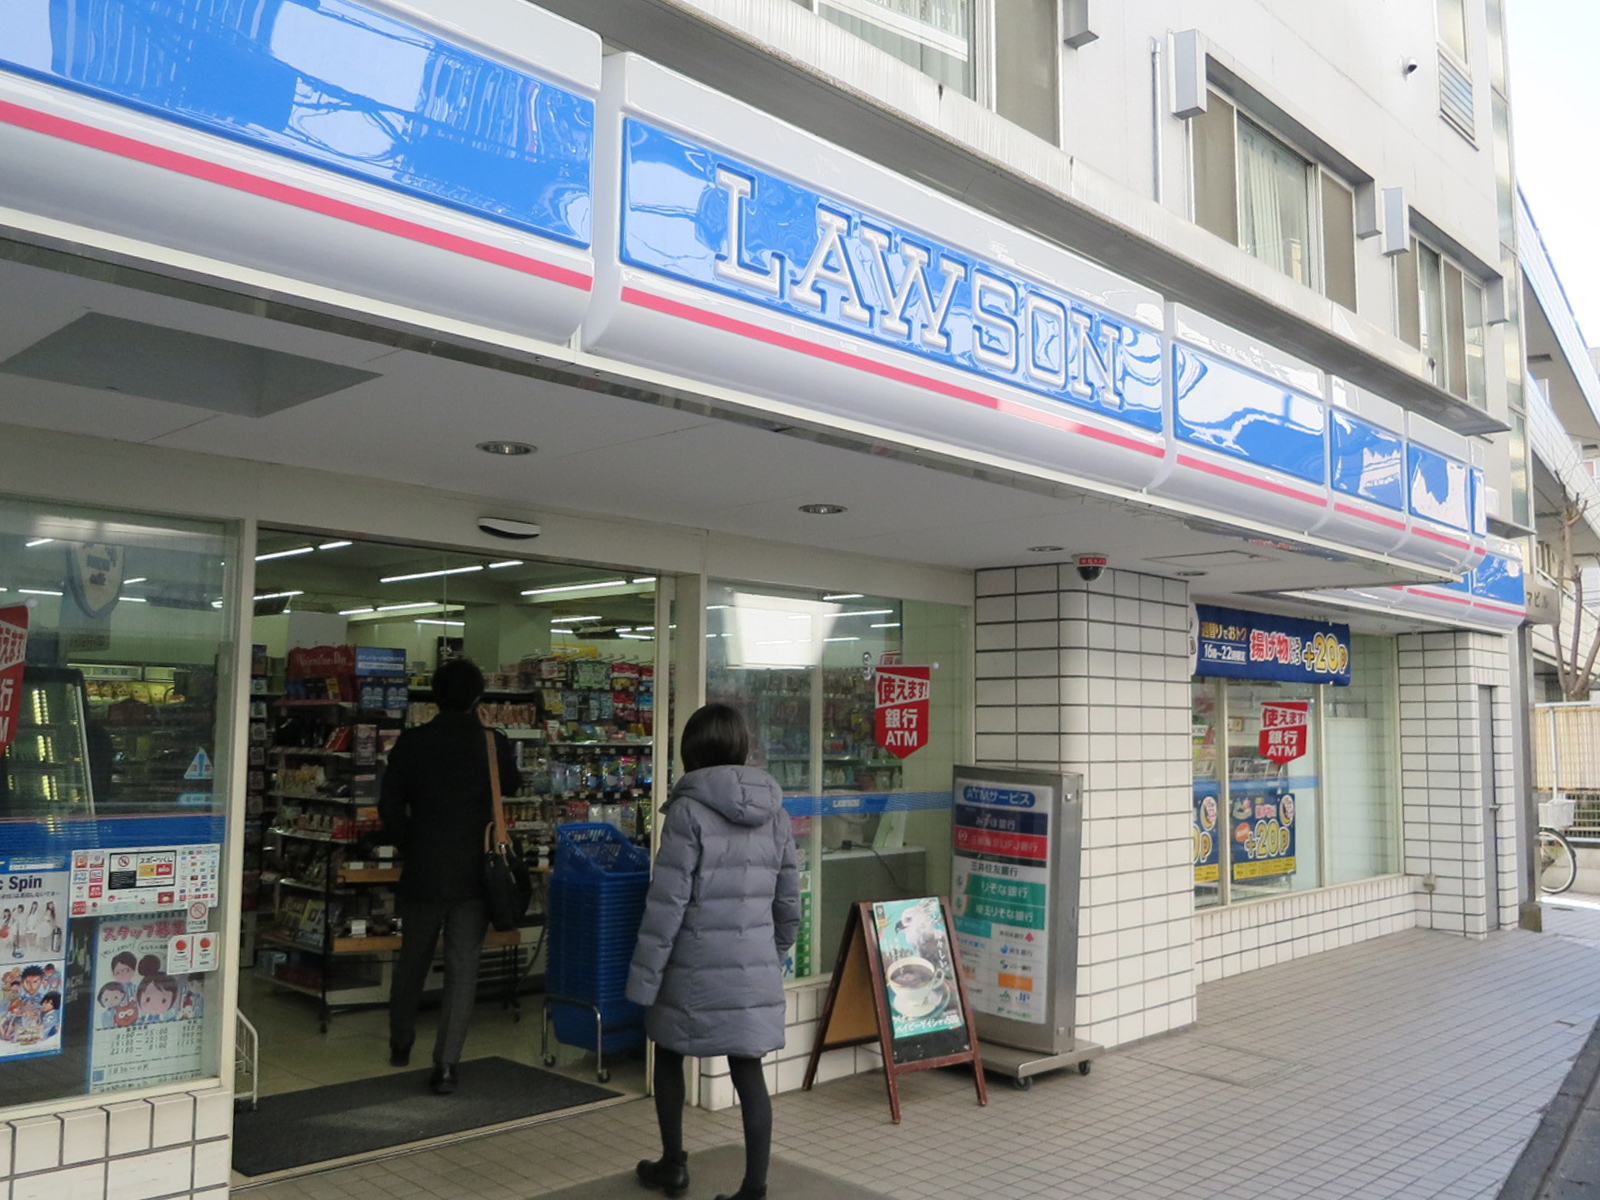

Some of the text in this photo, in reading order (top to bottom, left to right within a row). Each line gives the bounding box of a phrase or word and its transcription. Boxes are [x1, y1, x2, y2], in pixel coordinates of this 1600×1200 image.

[713, 163, 1124, 408] LAWSON
[885, 708, 918, 729] 銀行
[885, 730, 918, 746] ATM
[1268, 730, 1298, 745] 銀行
[1267, 745, 1297, 757] ATM
[966, 785, 1031, 806] ATMサービス
[971, 860, 1018, 878] 三井住友銀行
[8, 875, 42, 892] Spin
[981, 881, 1029, 899] りそな銀行
